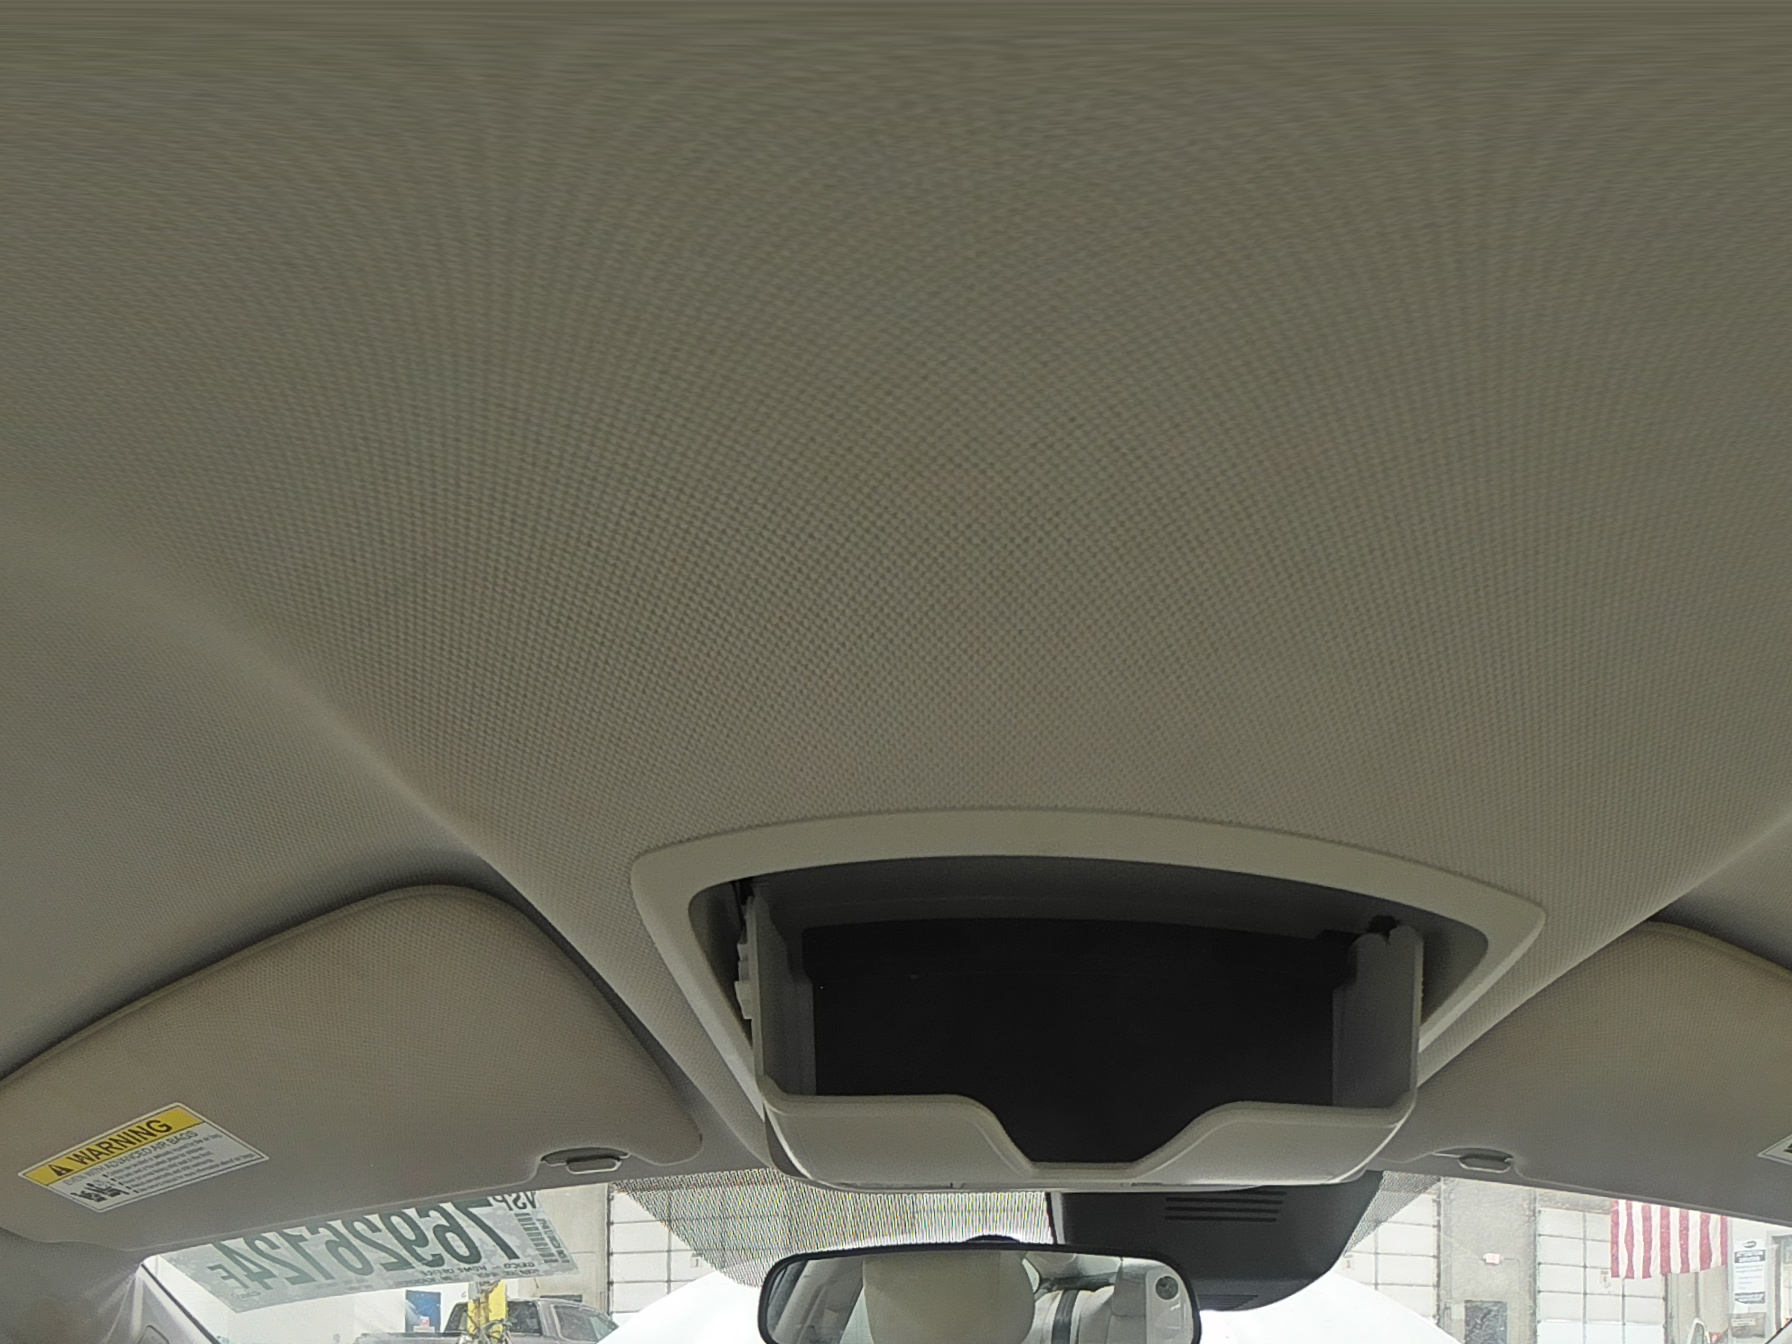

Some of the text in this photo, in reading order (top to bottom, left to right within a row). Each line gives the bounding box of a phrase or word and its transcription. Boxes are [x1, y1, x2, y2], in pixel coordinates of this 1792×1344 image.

[67, 1119, 172, 1165] WARNING
[84, 1167, 108, 1176] WITH
[103, 1148, 153, 1168] ADVANCED
[149, 1142, 170, 1150] AIR
[166, 1130, 198, 1143] BAGS
